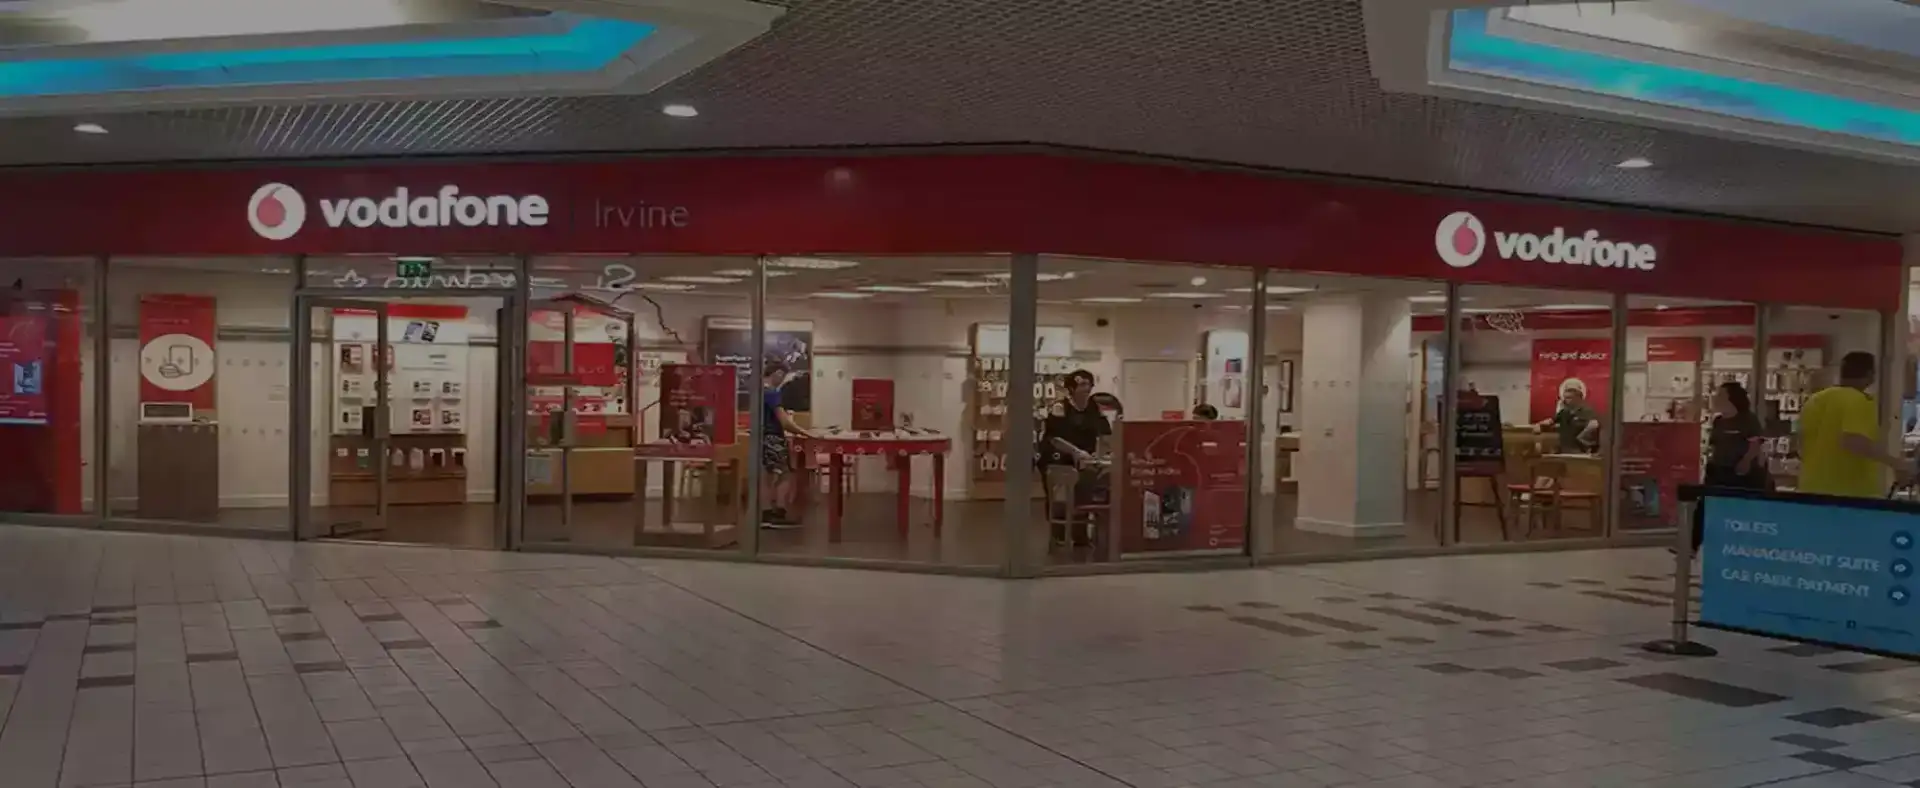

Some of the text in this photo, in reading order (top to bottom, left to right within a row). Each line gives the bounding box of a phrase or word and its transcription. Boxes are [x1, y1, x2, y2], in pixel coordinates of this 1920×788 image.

[320, 184, 549, 229] vodafone
[595, 199, 689, 230] Irvine
[1493, 226, 1657, 271] vodafone
[1538, 350, 1608, 361] Help and advice
[1723, 518, 1779, 535] TOILETS
[1721, 543, 1881, 573] MANAGEMENT SUITE
[1721, 568, 1871, 599] CAR PARK PAYMENT
